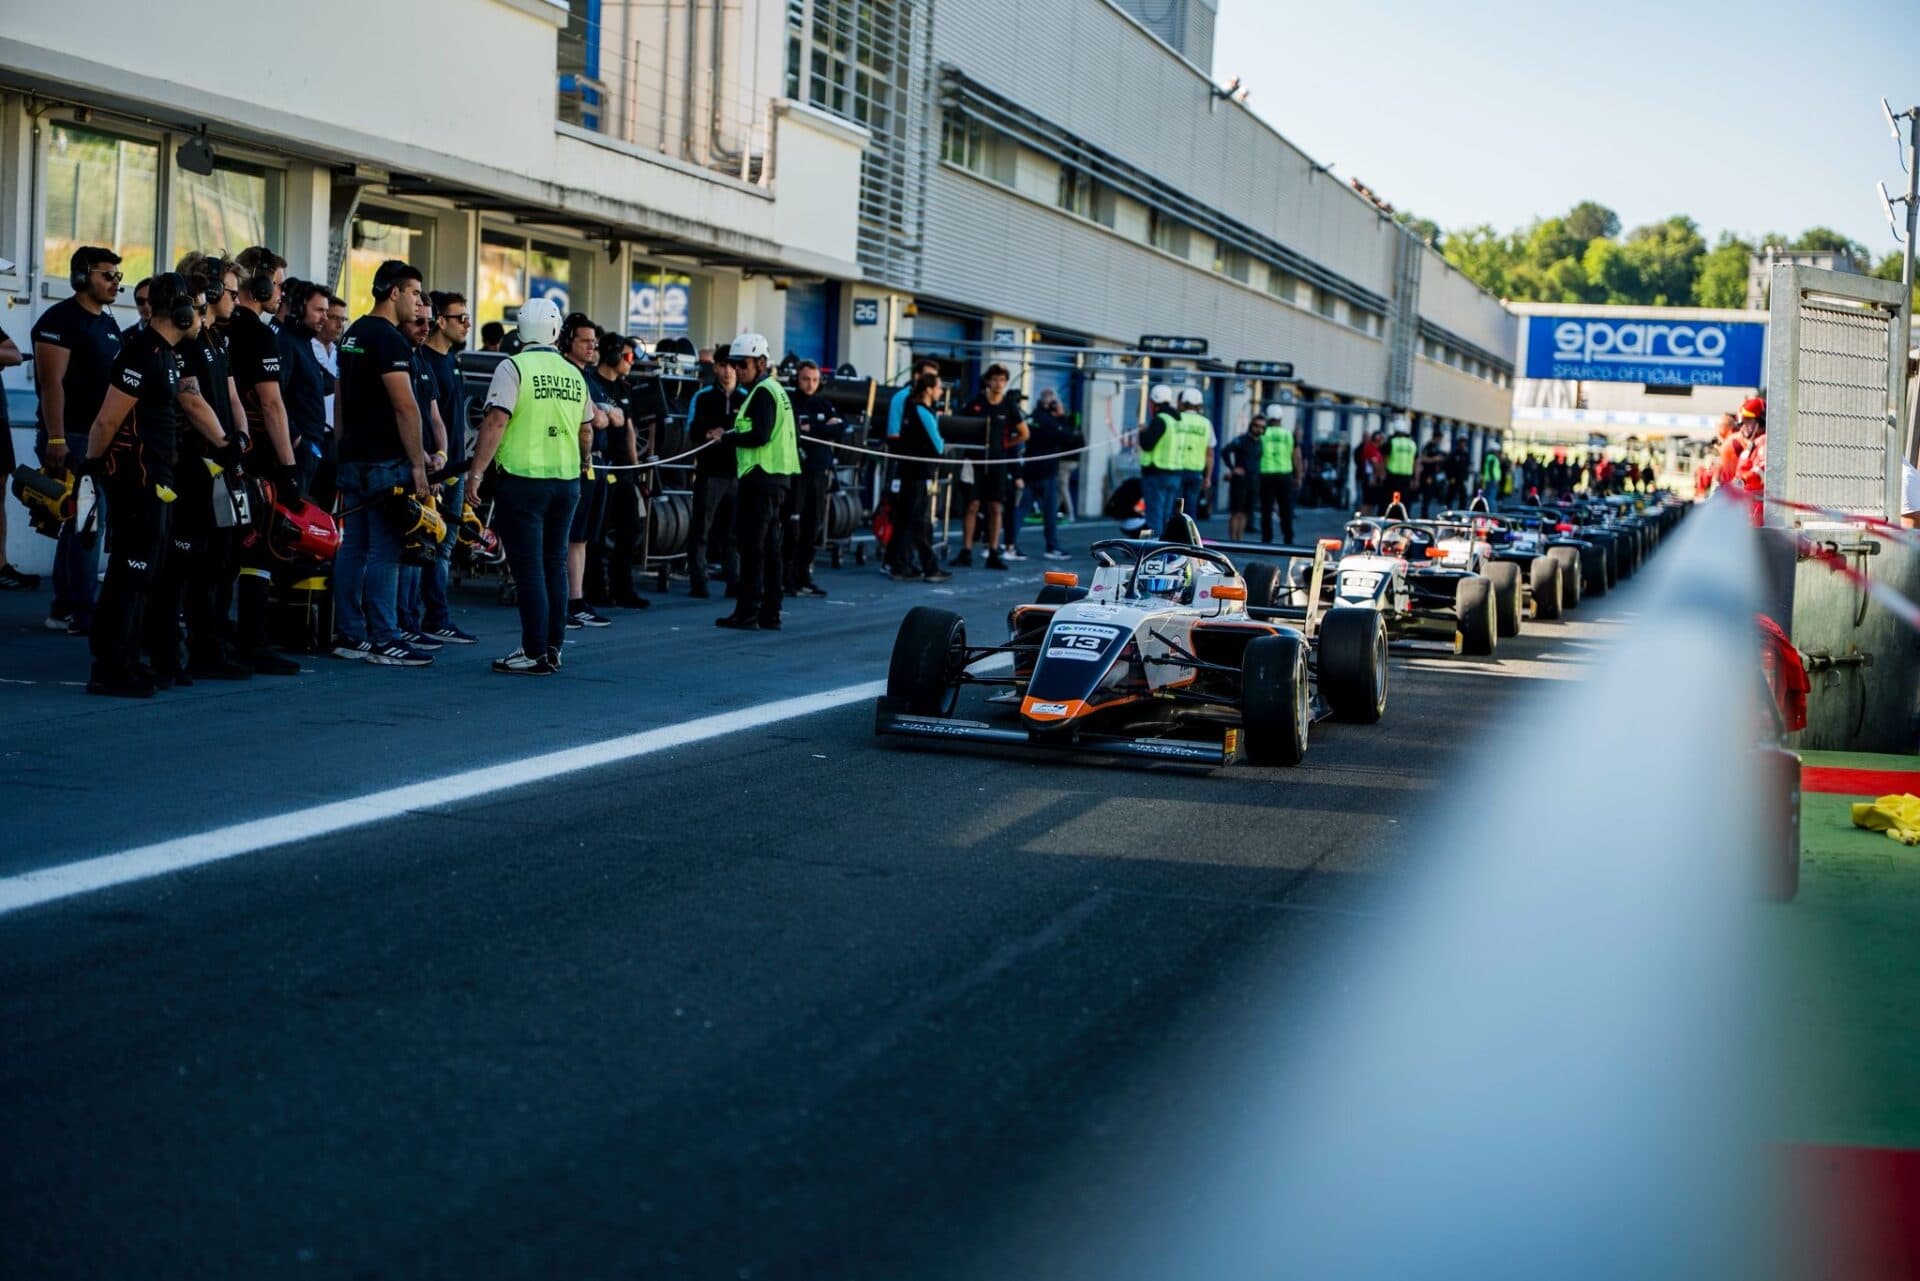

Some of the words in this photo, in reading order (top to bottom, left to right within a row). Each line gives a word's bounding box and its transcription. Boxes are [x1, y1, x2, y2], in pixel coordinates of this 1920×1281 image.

[855, 304, 877, 320] 26
[1554, 322, 1727, 363] sparco
[532, 375, 581, 391] SERVIZIO
[534, 388, 581, 403] CONTROLLO
[127, 559, 147, 570] VAR
[1061, 635, 1101, 650] 13
